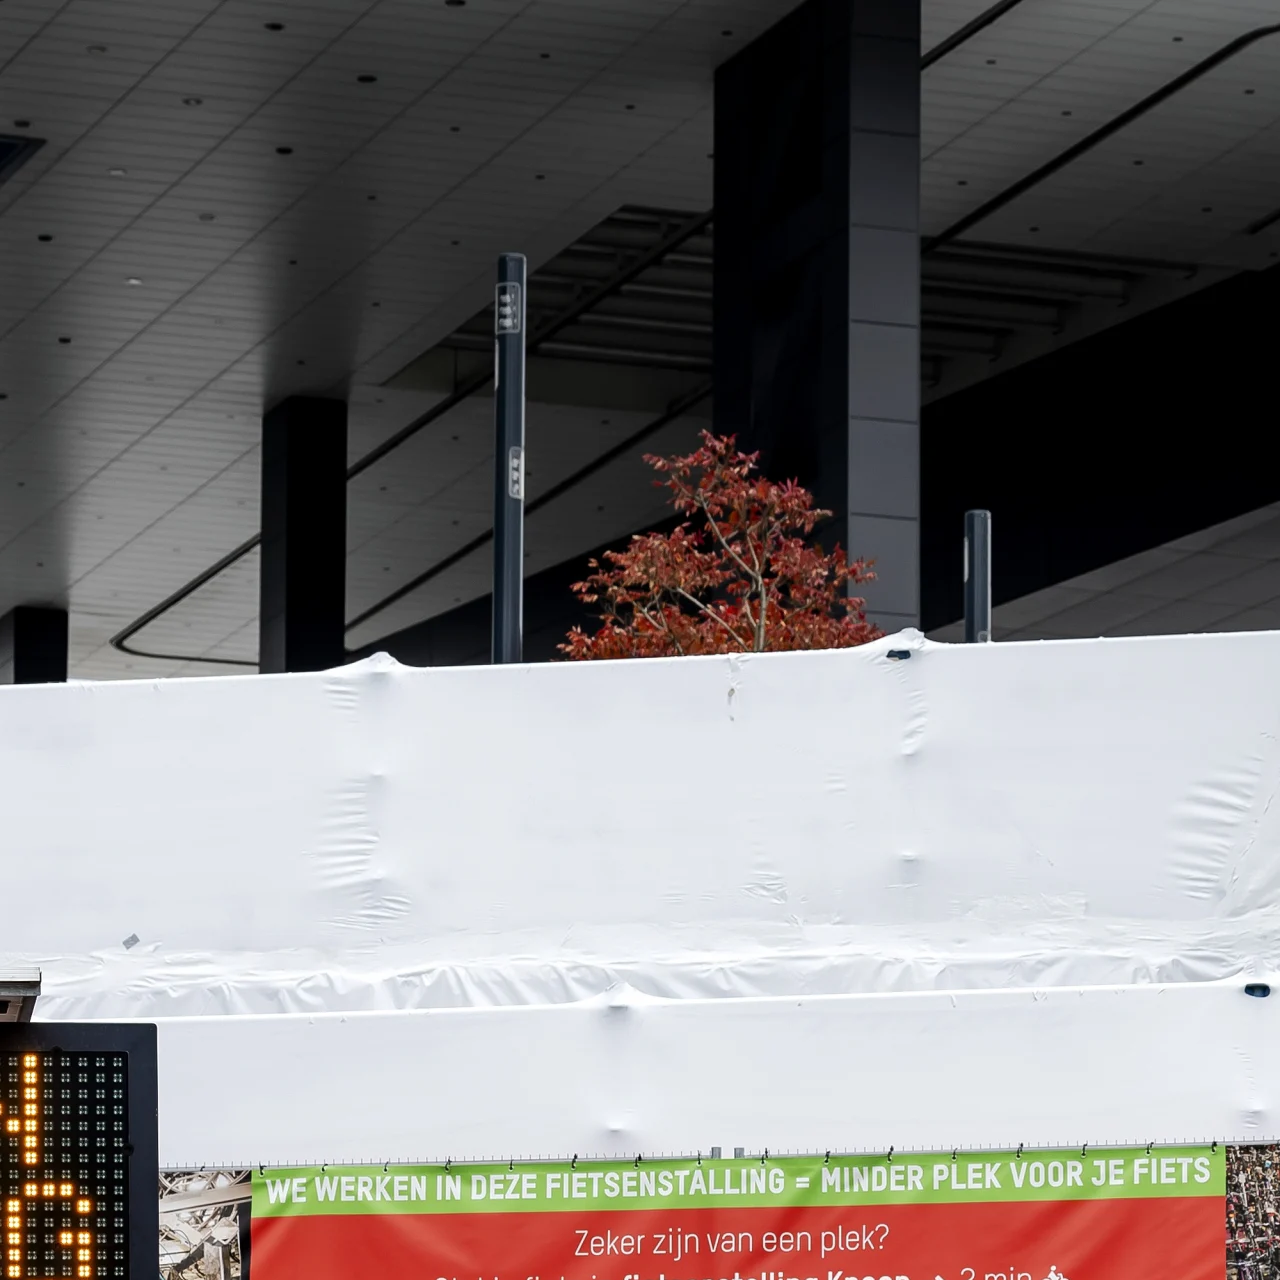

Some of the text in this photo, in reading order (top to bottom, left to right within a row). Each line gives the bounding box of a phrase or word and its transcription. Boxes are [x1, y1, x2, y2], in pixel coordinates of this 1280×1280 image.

[266, 1178, 306, 1204] WE
[315, 1176, 427, 1202] WERKEN
[437, 1175, 458, 1200] IN
[470, 1173, 537, 1200] DEZE
[546, 1168, 785, 1198] FIETSENSTALLING
[822, 1164, 923, 1193] MINDER
[933, 1162, 1001, 1190] PLEK
[1010, 1161, 1083, 1188] VOOR
[1091, 1160, 1124, 1187] JE
[1133, 1157, 1210, 1185] FIETS
[575, 1223, 890, 1261] Zeker zijn van een plek?
